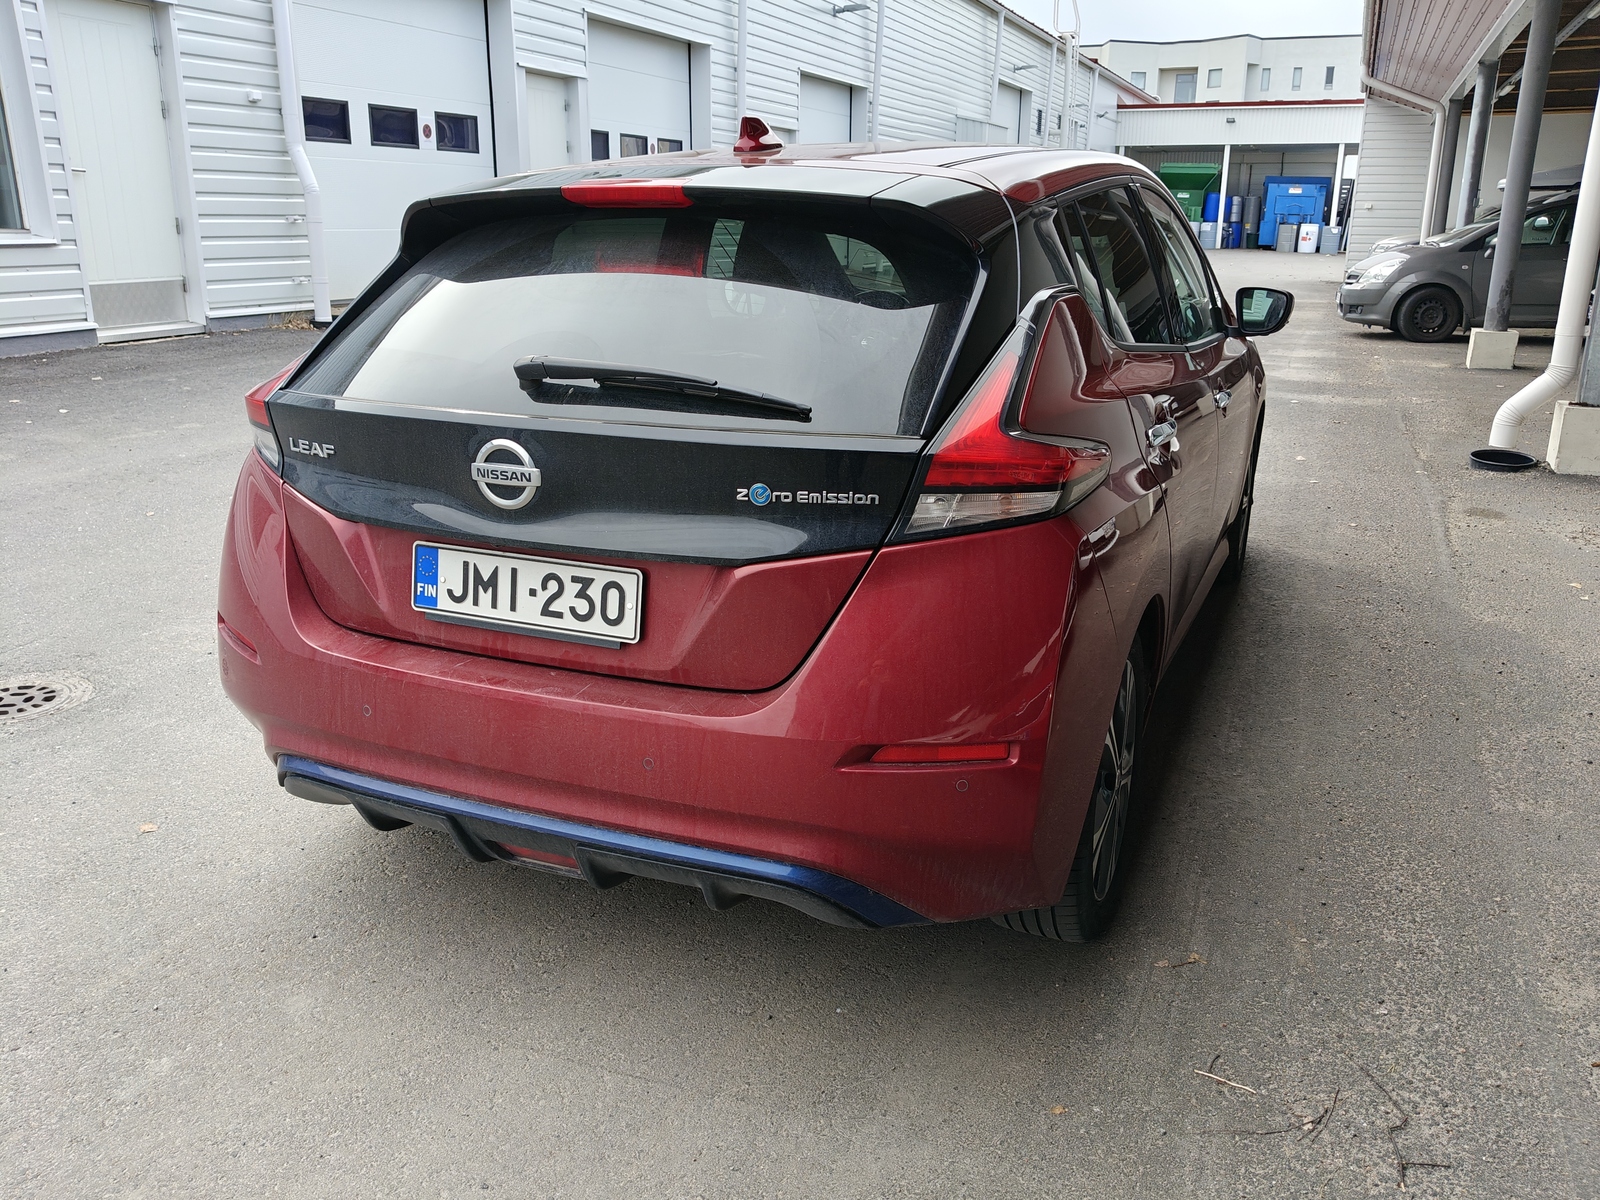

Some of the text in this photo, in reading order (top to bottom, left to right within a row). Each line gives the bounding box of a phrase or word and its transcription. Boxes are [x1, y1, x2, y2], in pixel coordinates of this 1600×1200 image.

[289, 437, 335, 458] LEAF
[476, 467, 532, 483] NISSAN
[796, 490, 880, 505] Emission
[416, 582, 437, 598] FIN
[446, 560, 626, 627] JMI-230
